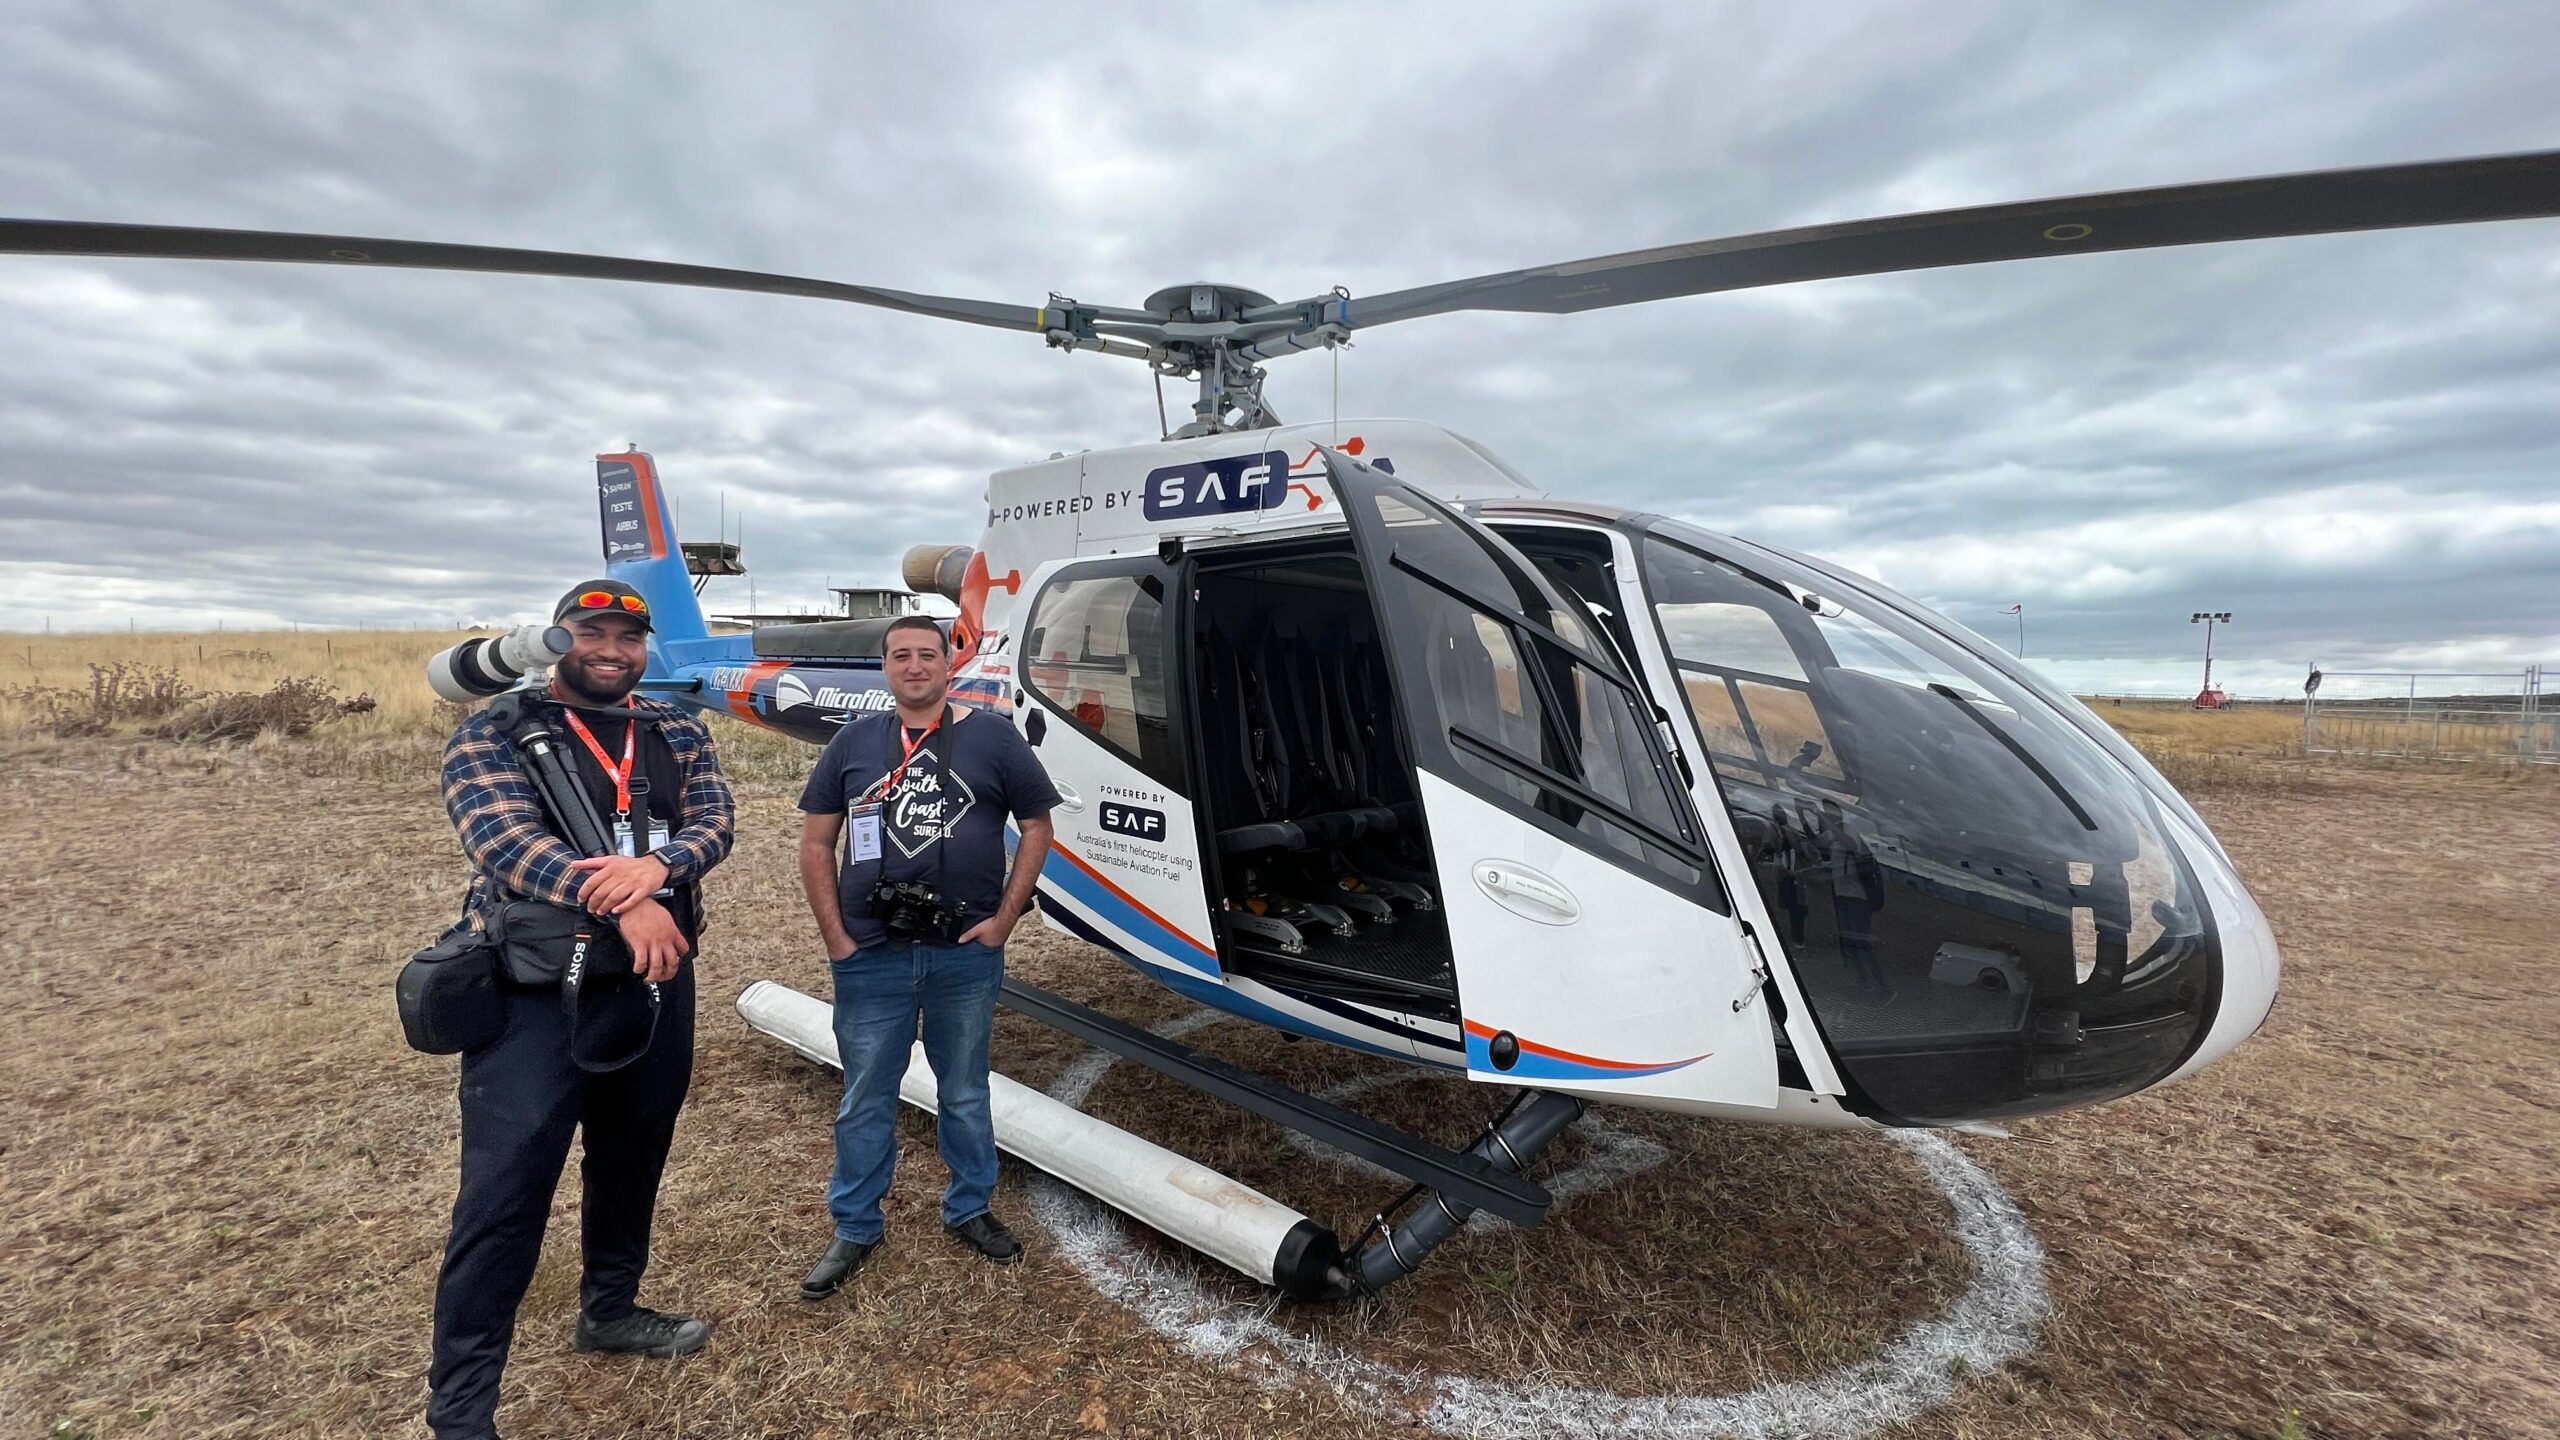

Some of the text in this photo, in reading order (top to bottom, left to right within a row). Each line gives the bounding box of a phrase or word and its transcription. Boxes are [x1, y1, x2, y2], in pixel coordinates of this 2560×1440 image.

[1159, 465, 1271, 508] SAF
[1002, 490, 1132, 523] POWERED BY
[814, 687, 897, 711] Microflite
[906, 767, 924, 777] THE
[895, 791, 942, 828] Coast
[1100, 785, 1165, 803] POWERED BY
[1106, 808, 1159, 832] SAF
[1076, 832, 1193, 870] Australia's first helicopter using
[1086, 849, 1181, 882] Sustainable Aviation Fuel
[567, 942, 586, 985] SONY
